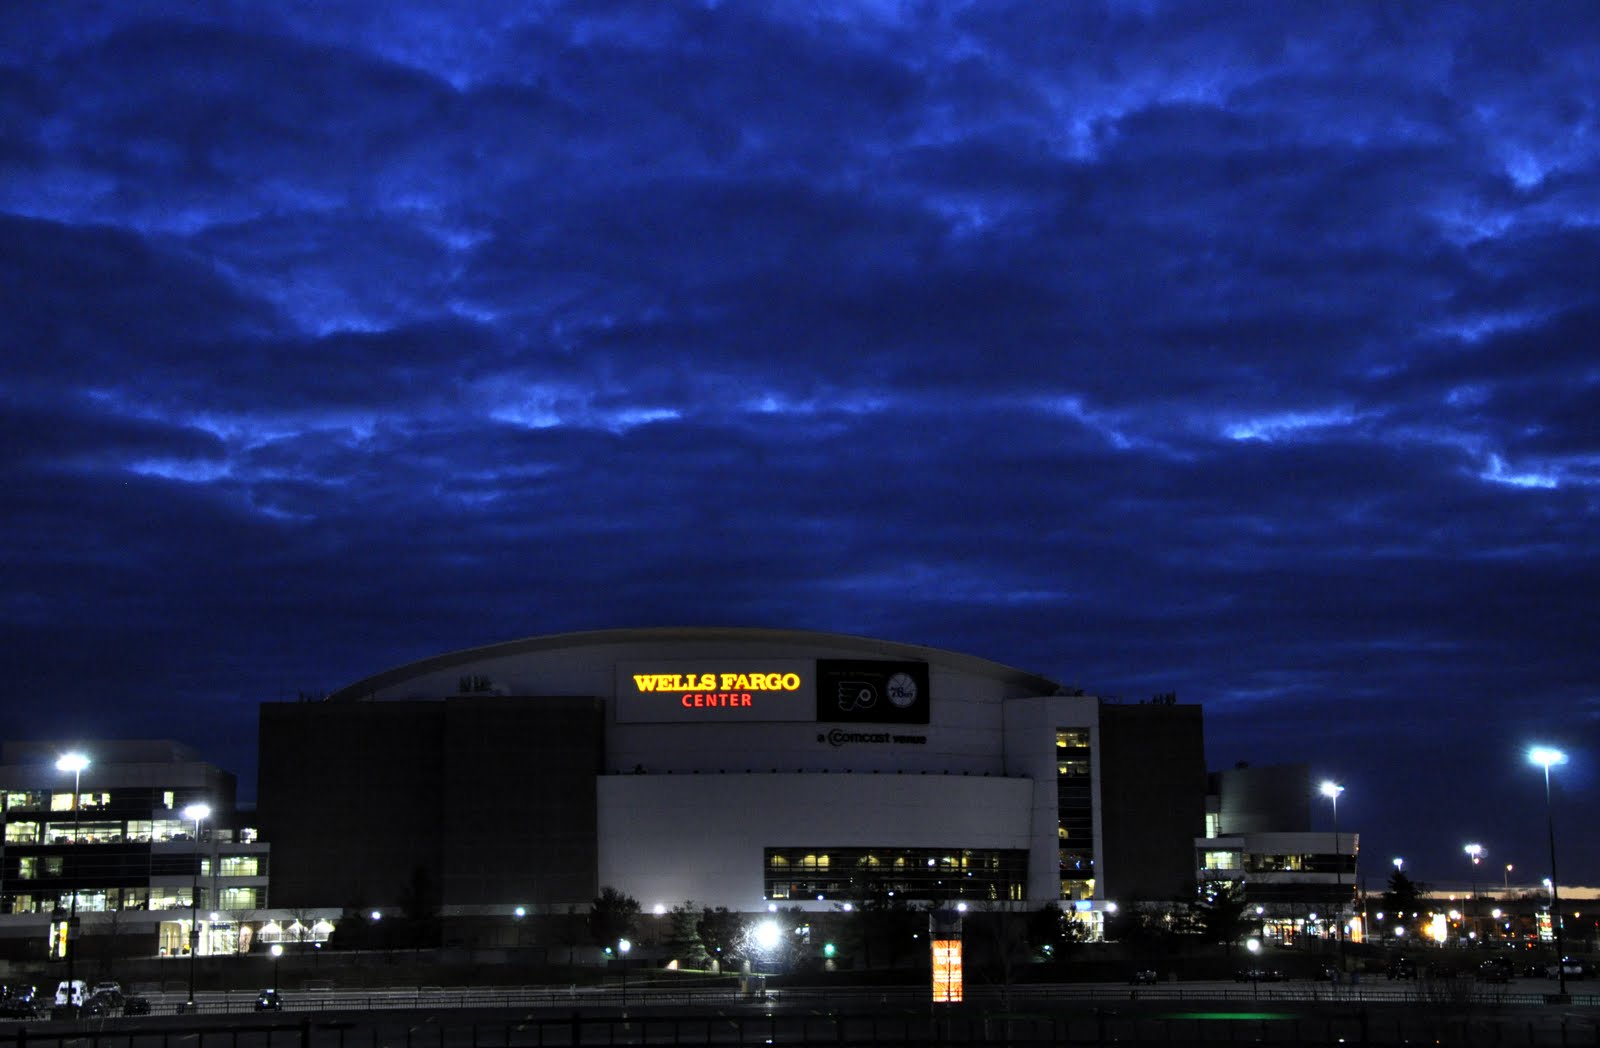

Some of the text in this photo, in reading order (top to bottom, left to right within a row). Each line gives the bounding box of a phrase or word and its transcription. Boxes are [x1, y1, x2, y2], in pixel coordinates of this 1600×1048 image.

[633, 673, 801, 692] WELLS FARGO
[682, 693, 752, 707] CENTER
